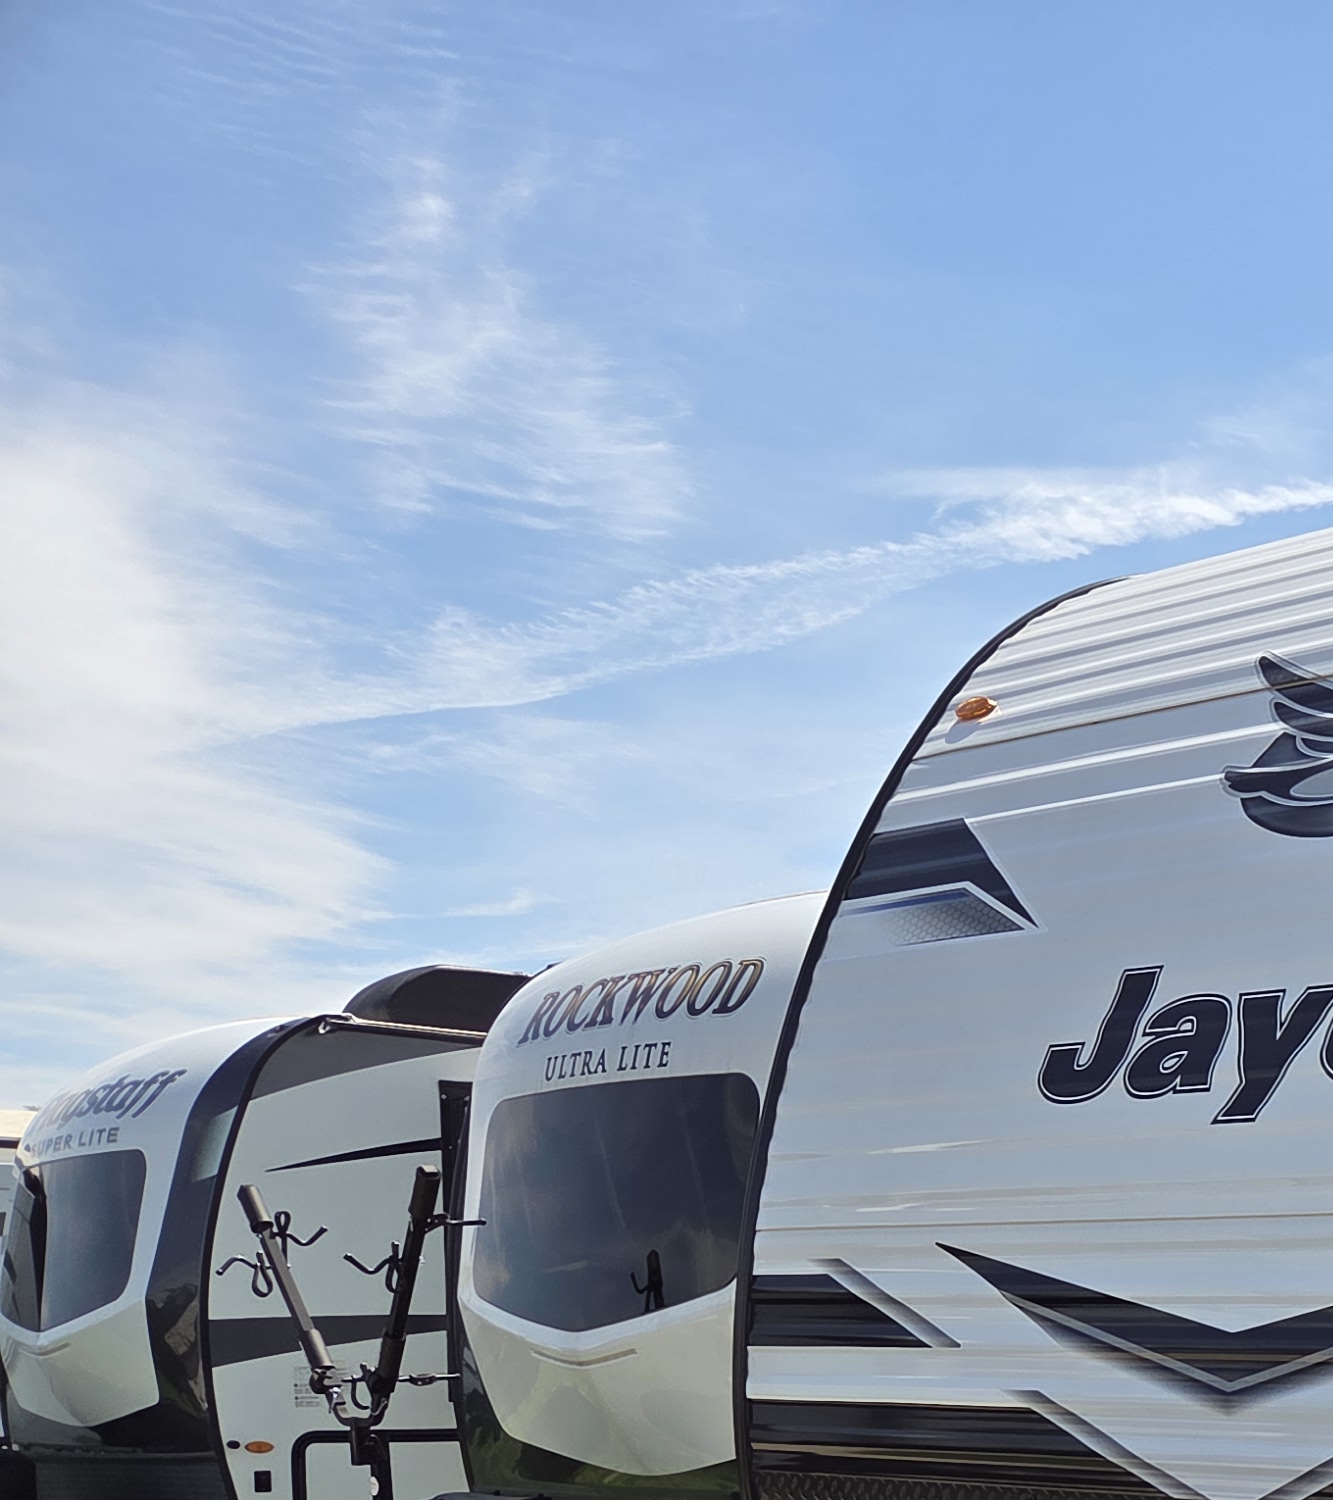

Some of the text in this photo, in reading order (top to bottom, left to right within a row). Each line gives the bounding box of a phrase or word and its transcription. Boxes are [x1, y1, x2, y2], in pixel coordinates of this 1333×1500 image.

[516, 956, 768, 1048] ROCKWOOD
[544, 1041, 672, 1082] ULTRA LITE
[30, 1068, 188, 1134] lagstaff
[31, 1126, 120, 1158] SUPER LITE
